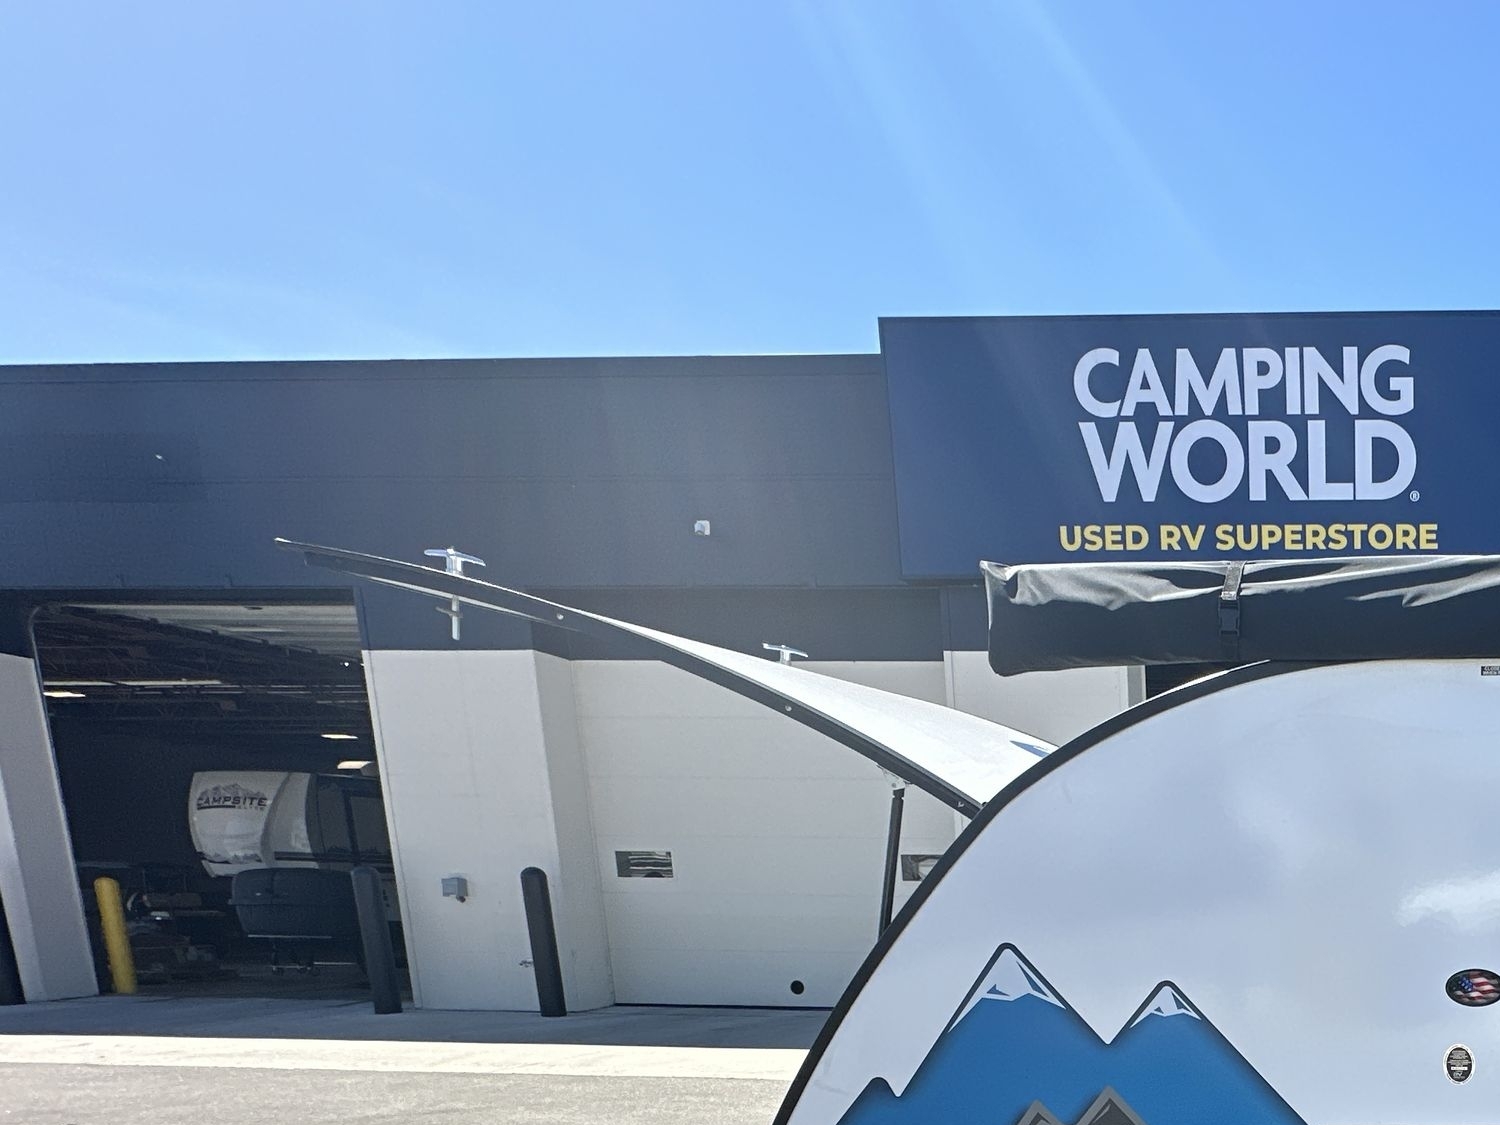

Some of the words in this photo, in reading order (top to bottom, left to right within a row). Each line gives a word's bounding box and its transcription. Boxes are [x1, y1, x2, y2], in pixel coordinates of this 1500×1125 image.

[1073, 344, 1415, 418] CAMPING
[1059, 524, 1149, 551] USED
[1160, 524, 1205, 551] RV
[1215, 523, 1439, 551] SUPERSTORE
[196, 796, 268, 807] CAMPSITE
